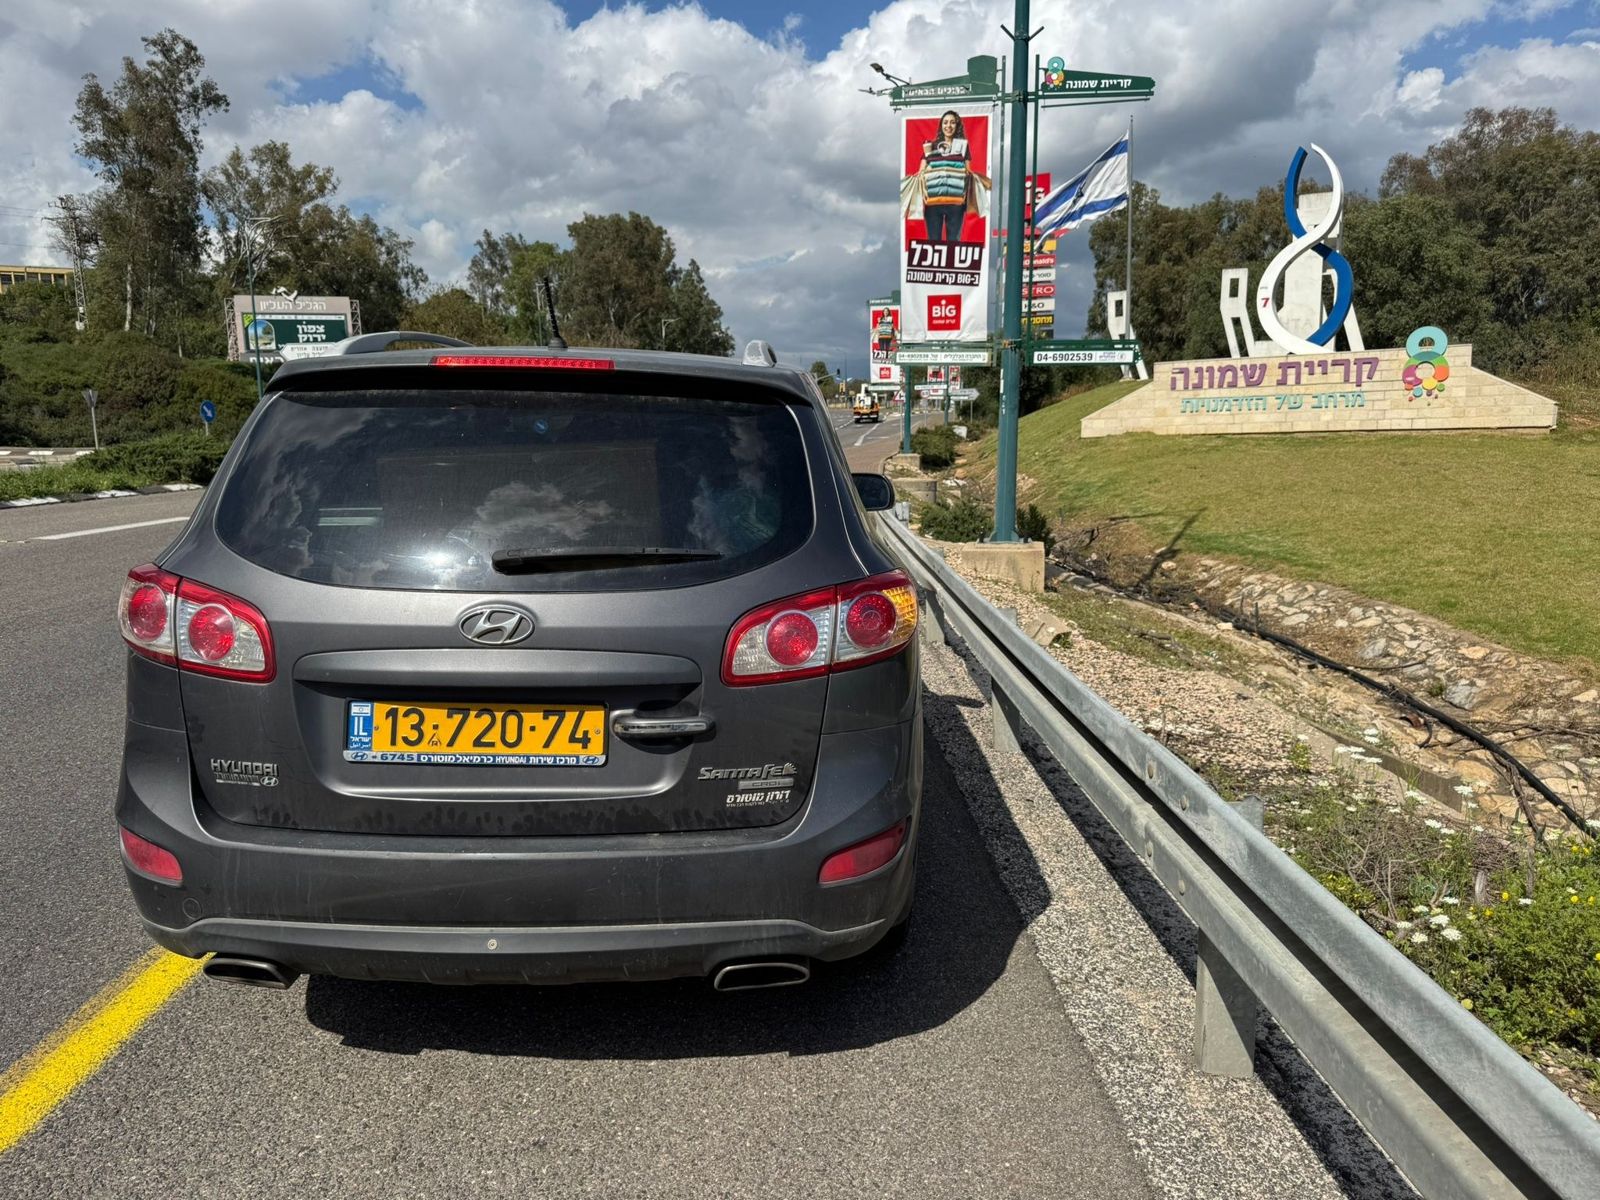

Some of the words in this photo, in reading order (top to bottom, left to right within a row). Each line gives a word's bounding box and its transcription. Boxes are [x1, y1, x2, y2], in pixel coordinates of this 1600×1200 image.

[1065, 80, 1098, 89] שמונה
[1100, 79, 1132, 89] קריית
[908, 88, 935, 96] הבאים
[910, 240, 948, 267] הכל
[953, 246, 980, 268] יש
[907, 271, 934, 282] שמונה
[935, 272, 956, 285] קרית
[260, 300, 293, 312] העליון
[295, 299, 327, 311] הגליל
[1261, 297, 1270, 308] 7
[298, 333, 326, 343] ירוק
[1037, 353, 1093, 361] 04-6902539
[1170, 363, 1267, 391] שמונה
[1276, 357, 1379, 387] קריית
[1180, 397, 1267, 413] הזדמנויות
[1275, 394, 1303, 410] של
[1311, 391, 1365, 409] מרחב
[354, 717, 368, 735] IL
[496, 755, 527, 763] HYUNDAI
[529, 756, 554, 764] שירות
[556, 756, 577, 764] מרכז
[210, 758, 278, 776] HYUNDAI
[726, 792, 765, 803] מוטורס
[765, 790, 791, 802] דורון
